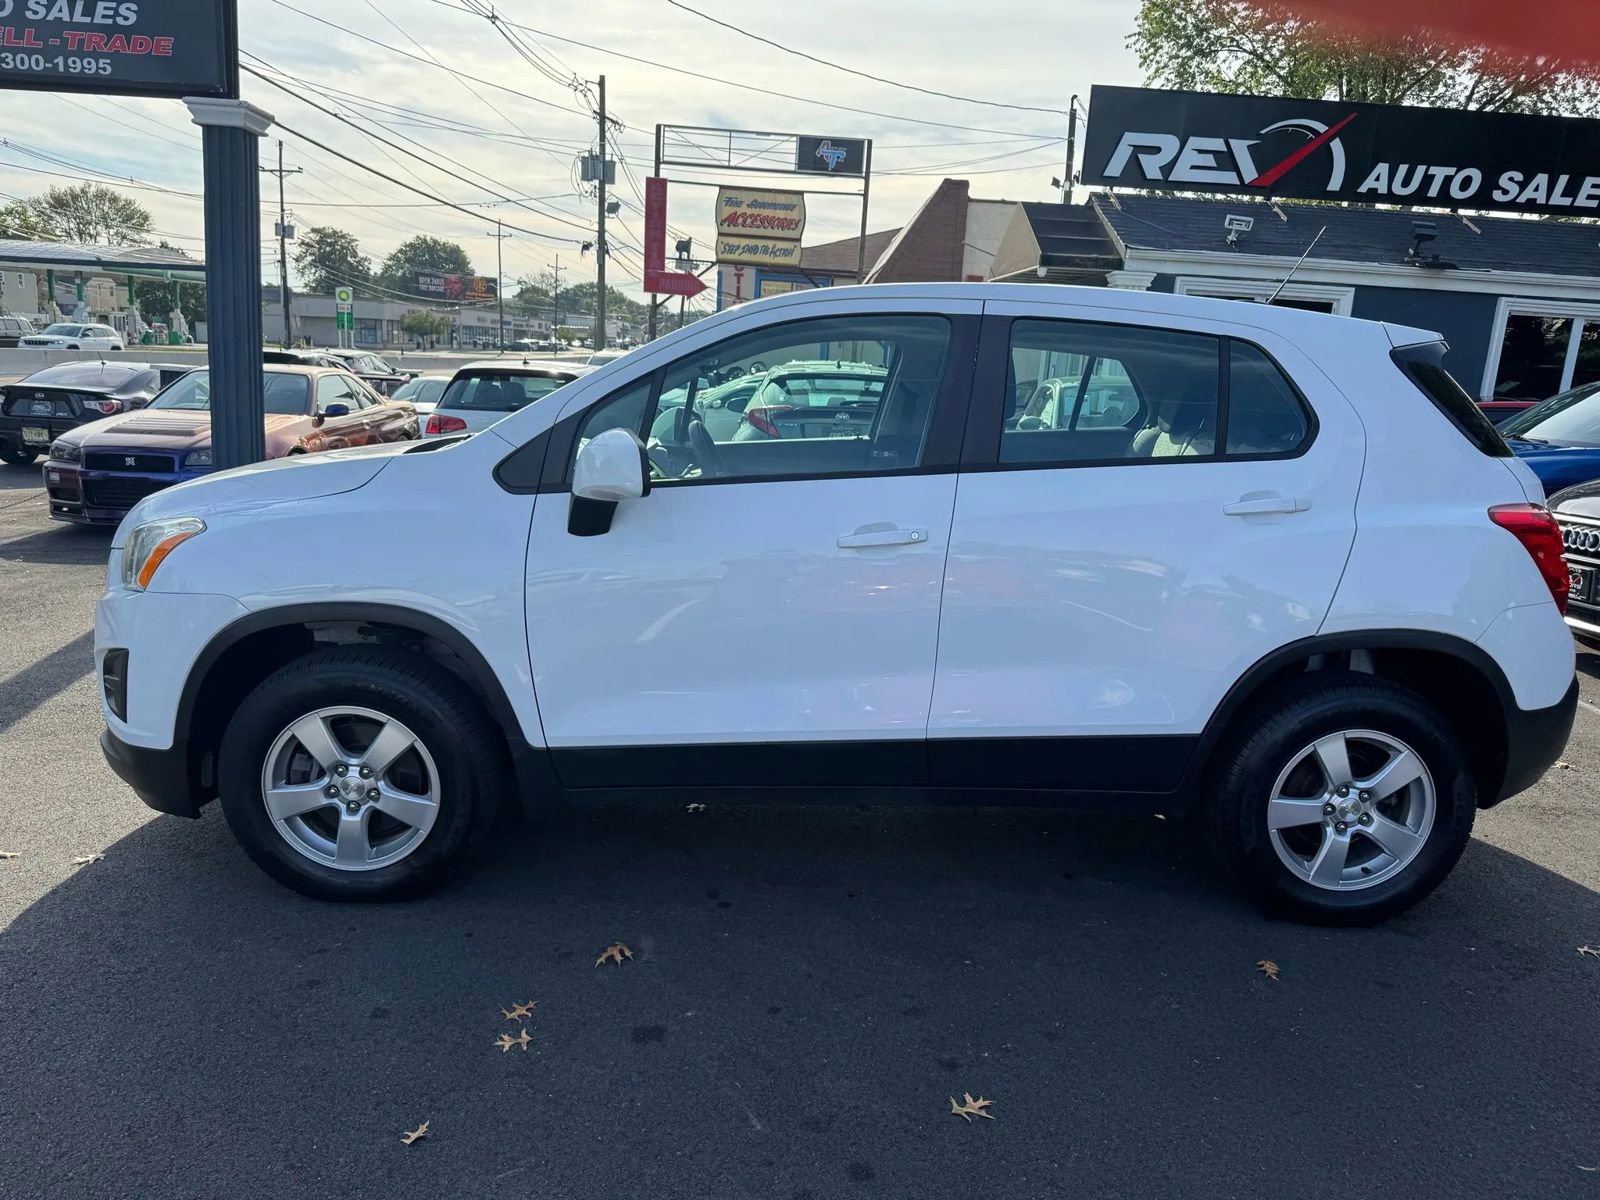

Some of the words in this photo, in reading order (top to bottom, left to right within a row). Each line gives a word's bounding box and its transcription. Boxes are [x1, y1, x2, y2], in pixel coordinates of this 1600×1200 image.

[25, 0, 138, 26] SALES
[0, 27, 43, 48] LL
[63, 31, 174, 56] TRADE
[1, 53, 112, 75] 300-1995
[1357, 162, 1482, 200] AUTO
[1492, 170, 1600, 208] SALE
[720, 211, 801, 231] ACCESSORIES
